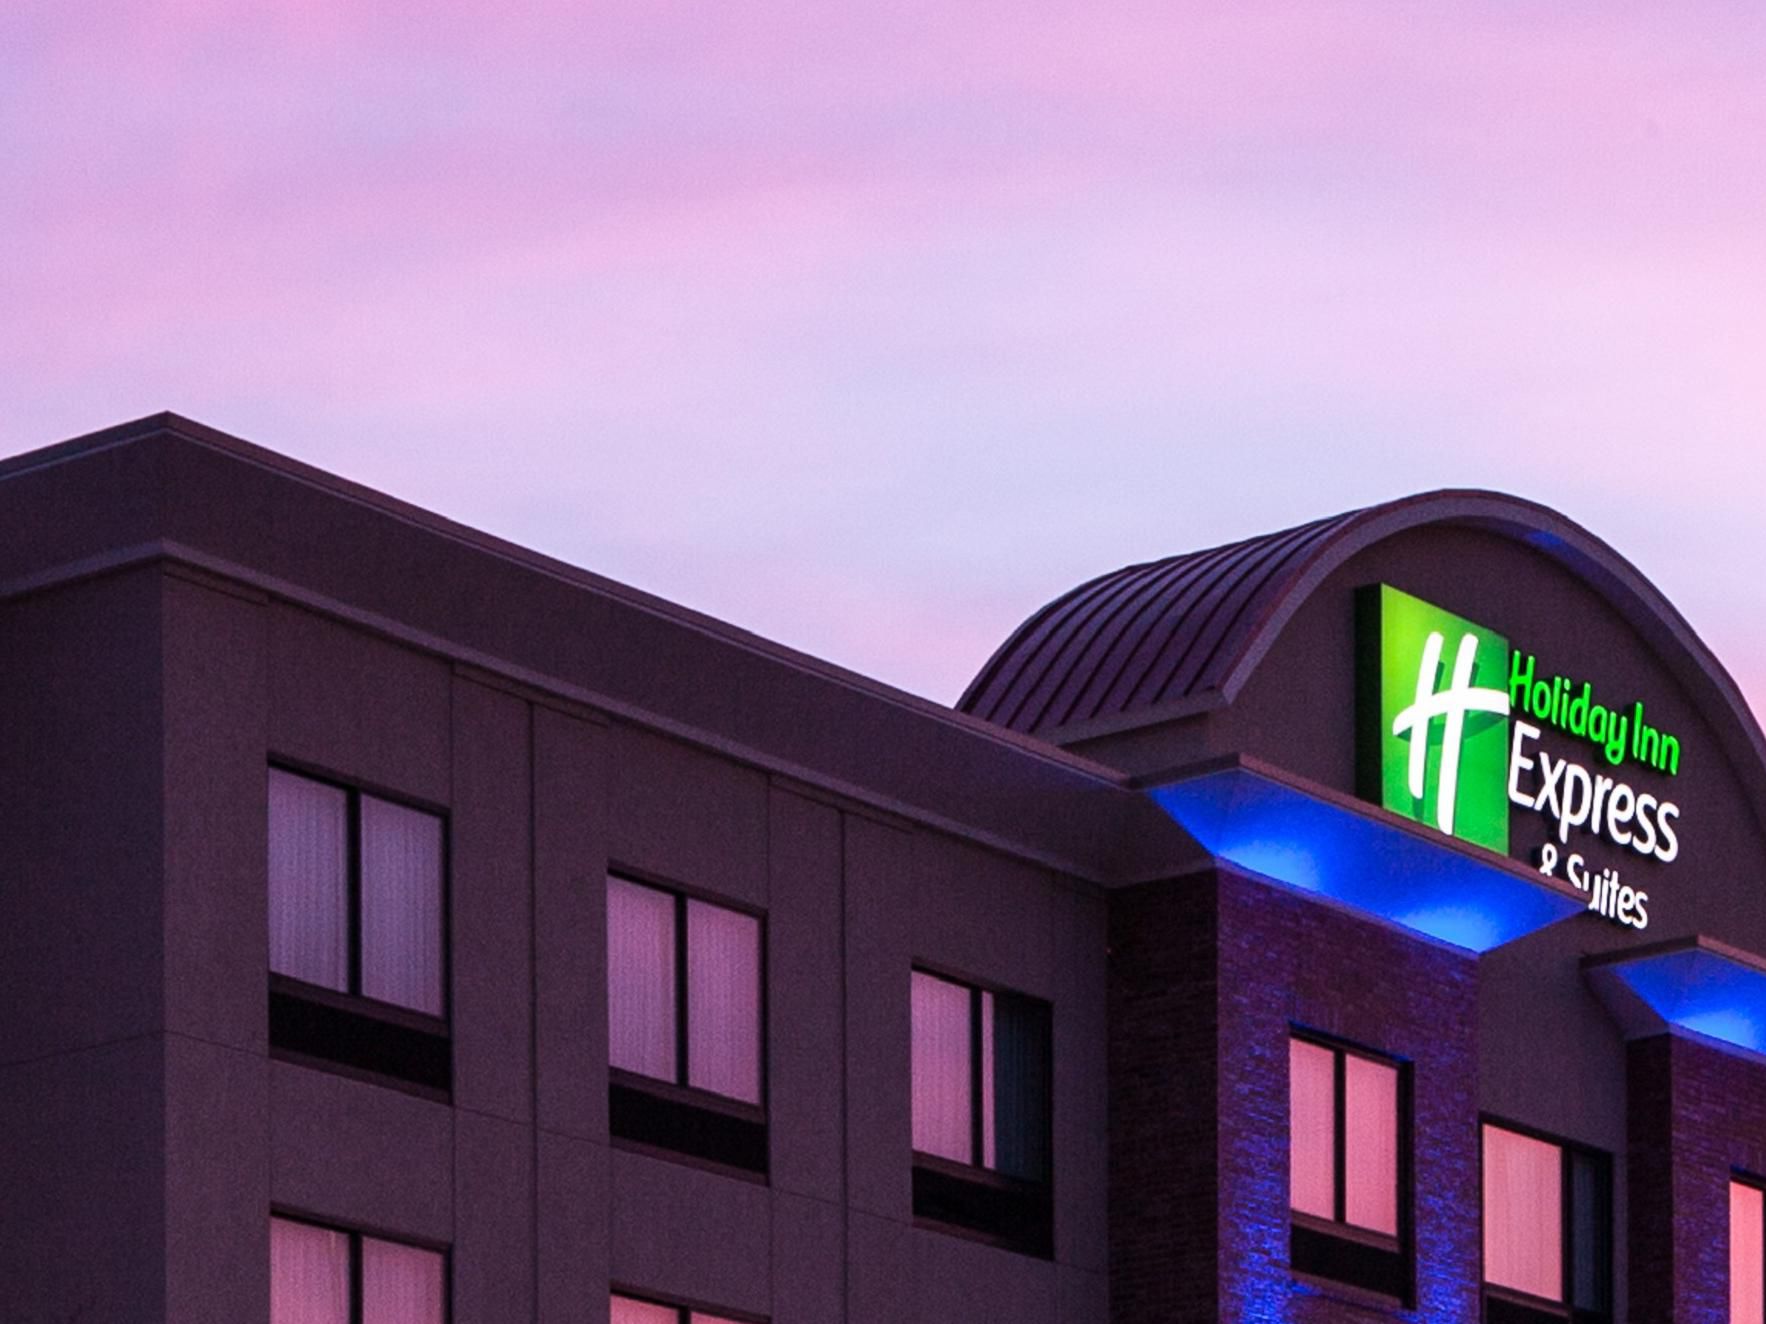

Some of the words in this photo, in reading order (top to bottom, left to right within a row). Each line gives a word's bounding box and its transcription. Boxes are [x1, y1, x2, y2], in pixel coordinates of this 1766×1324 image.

[1509, 650, 1628, 766] Holiday
[1632, 702, 1681, 776] Inn
[1507, 719, 1681, 863] Express
